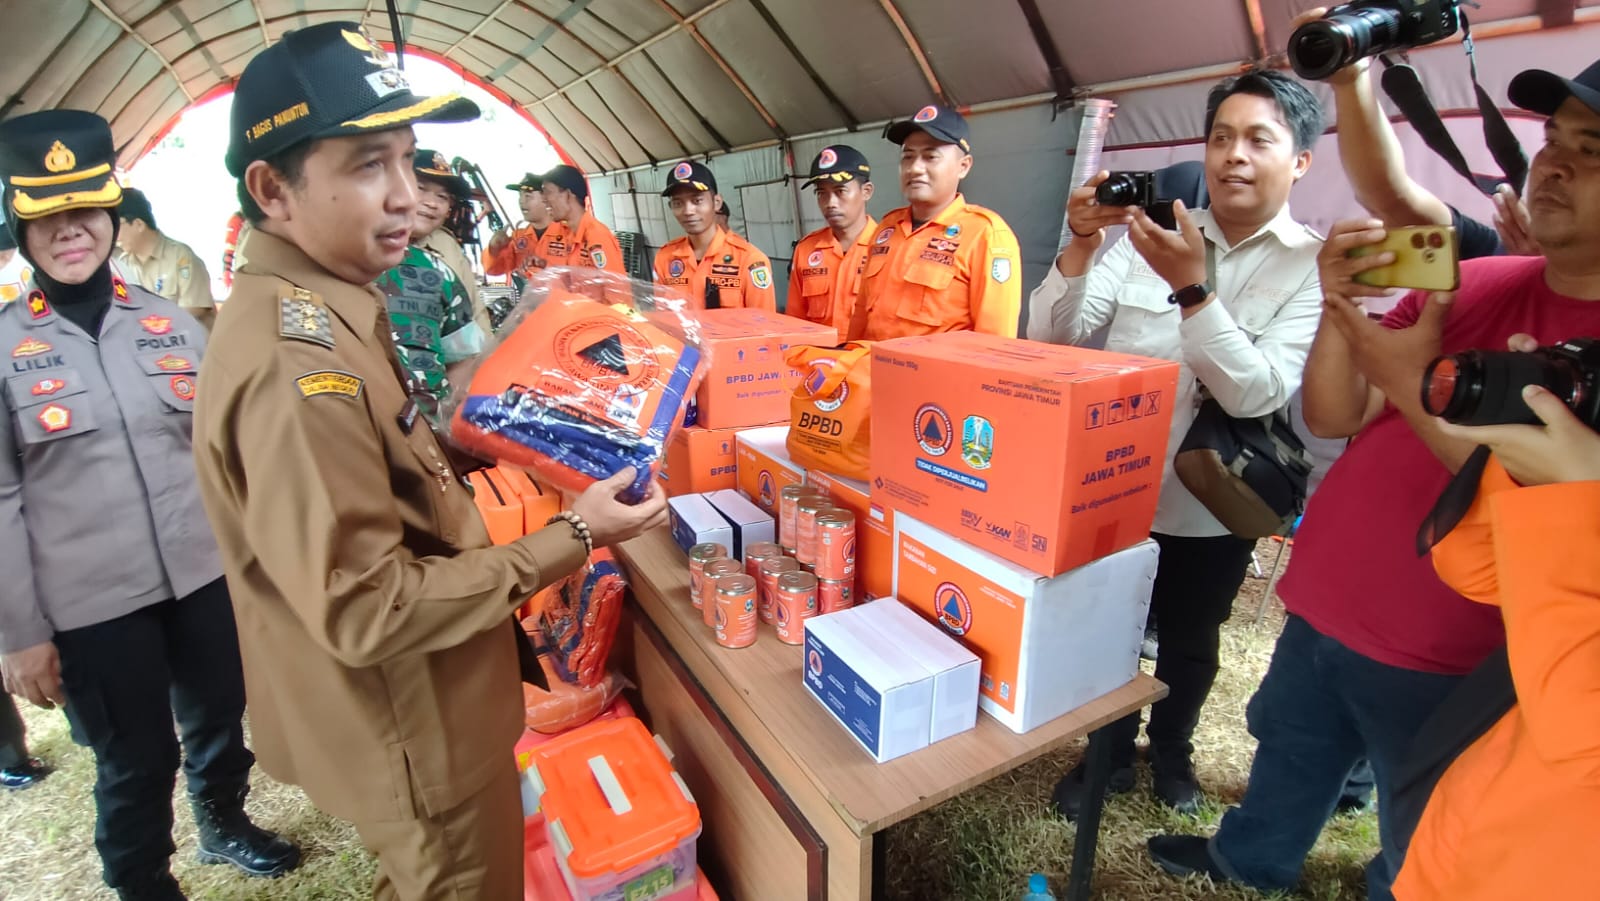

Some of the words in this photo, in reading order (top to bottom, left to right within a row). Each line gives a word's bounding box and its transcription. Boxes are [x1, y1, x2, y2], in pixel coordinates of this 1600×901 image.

[252, 118, 273, 139] BAGUS
[398, 299, 420, 313] TNI
[135, 334, 188, 351] POLRI
[12, 354, 65, 373] LILIK
[725, 374, 754, 384] BPBD
[758, 371, 781, 381] JAW
[981, 383, 1012, 396] PROVINSI
[1014, 390, 1034, 401] JAWA
[1036, 395, 1061, 406] TIMUR
[798, 412, 843, 437] BPBD
[1105, 445, 1135, 462] BPBD
[711, 465, 737, 476] BPBD
[1081, 466, 1115, 485] JAWA
[1118, 456, 1152, 475] TIMUR
[1071, 502, 1087, 514] Baik
